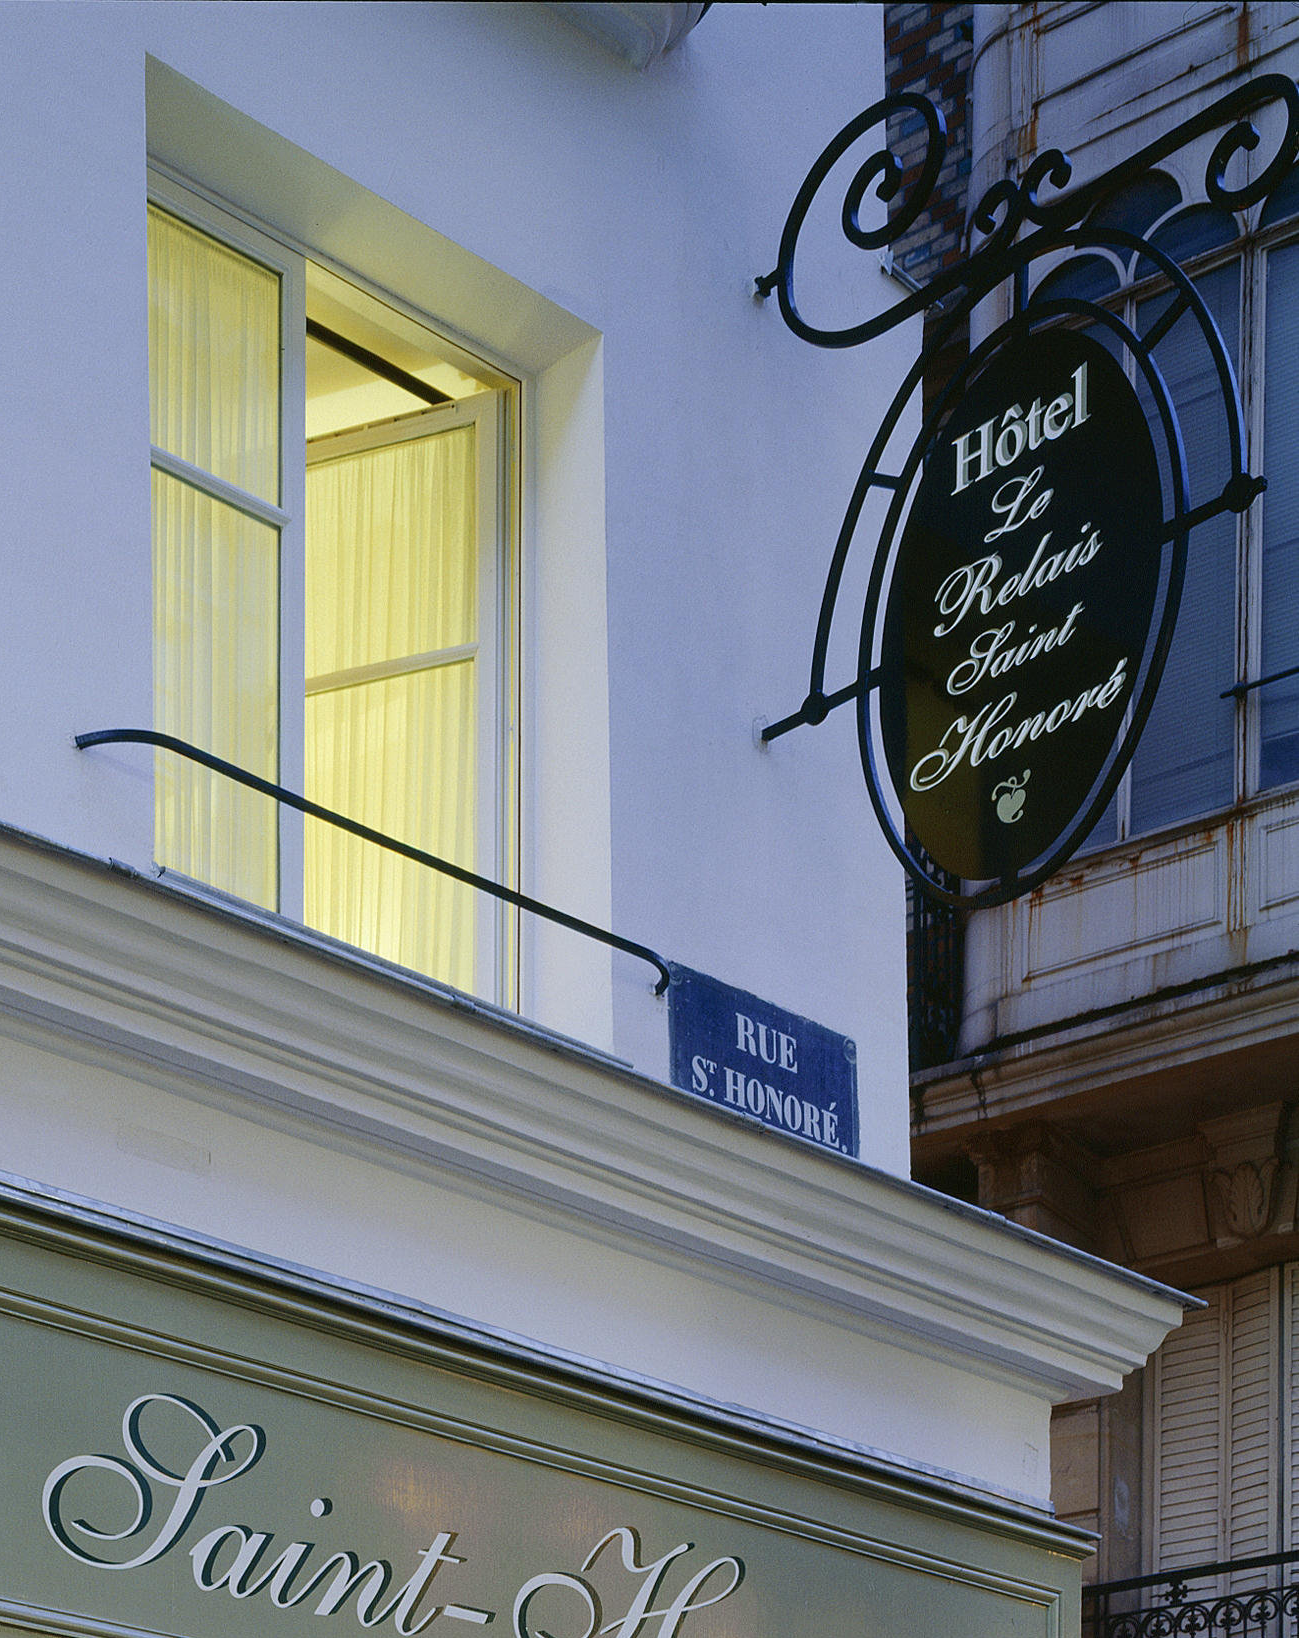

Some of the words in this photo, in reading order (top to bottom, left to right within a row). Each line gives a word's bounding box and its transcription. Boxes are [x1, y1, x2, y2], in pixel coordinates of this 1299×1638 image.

[951, 360, 1092, 496] Hôtel
[984, 464, 1054, 543] Le
[933, 521, 1103, 638] Relais
[946, 600, 1086, 696] Saint
[909, 656, 1128, 792] Honoré
[735, 1012, 798, 1073] RUE
